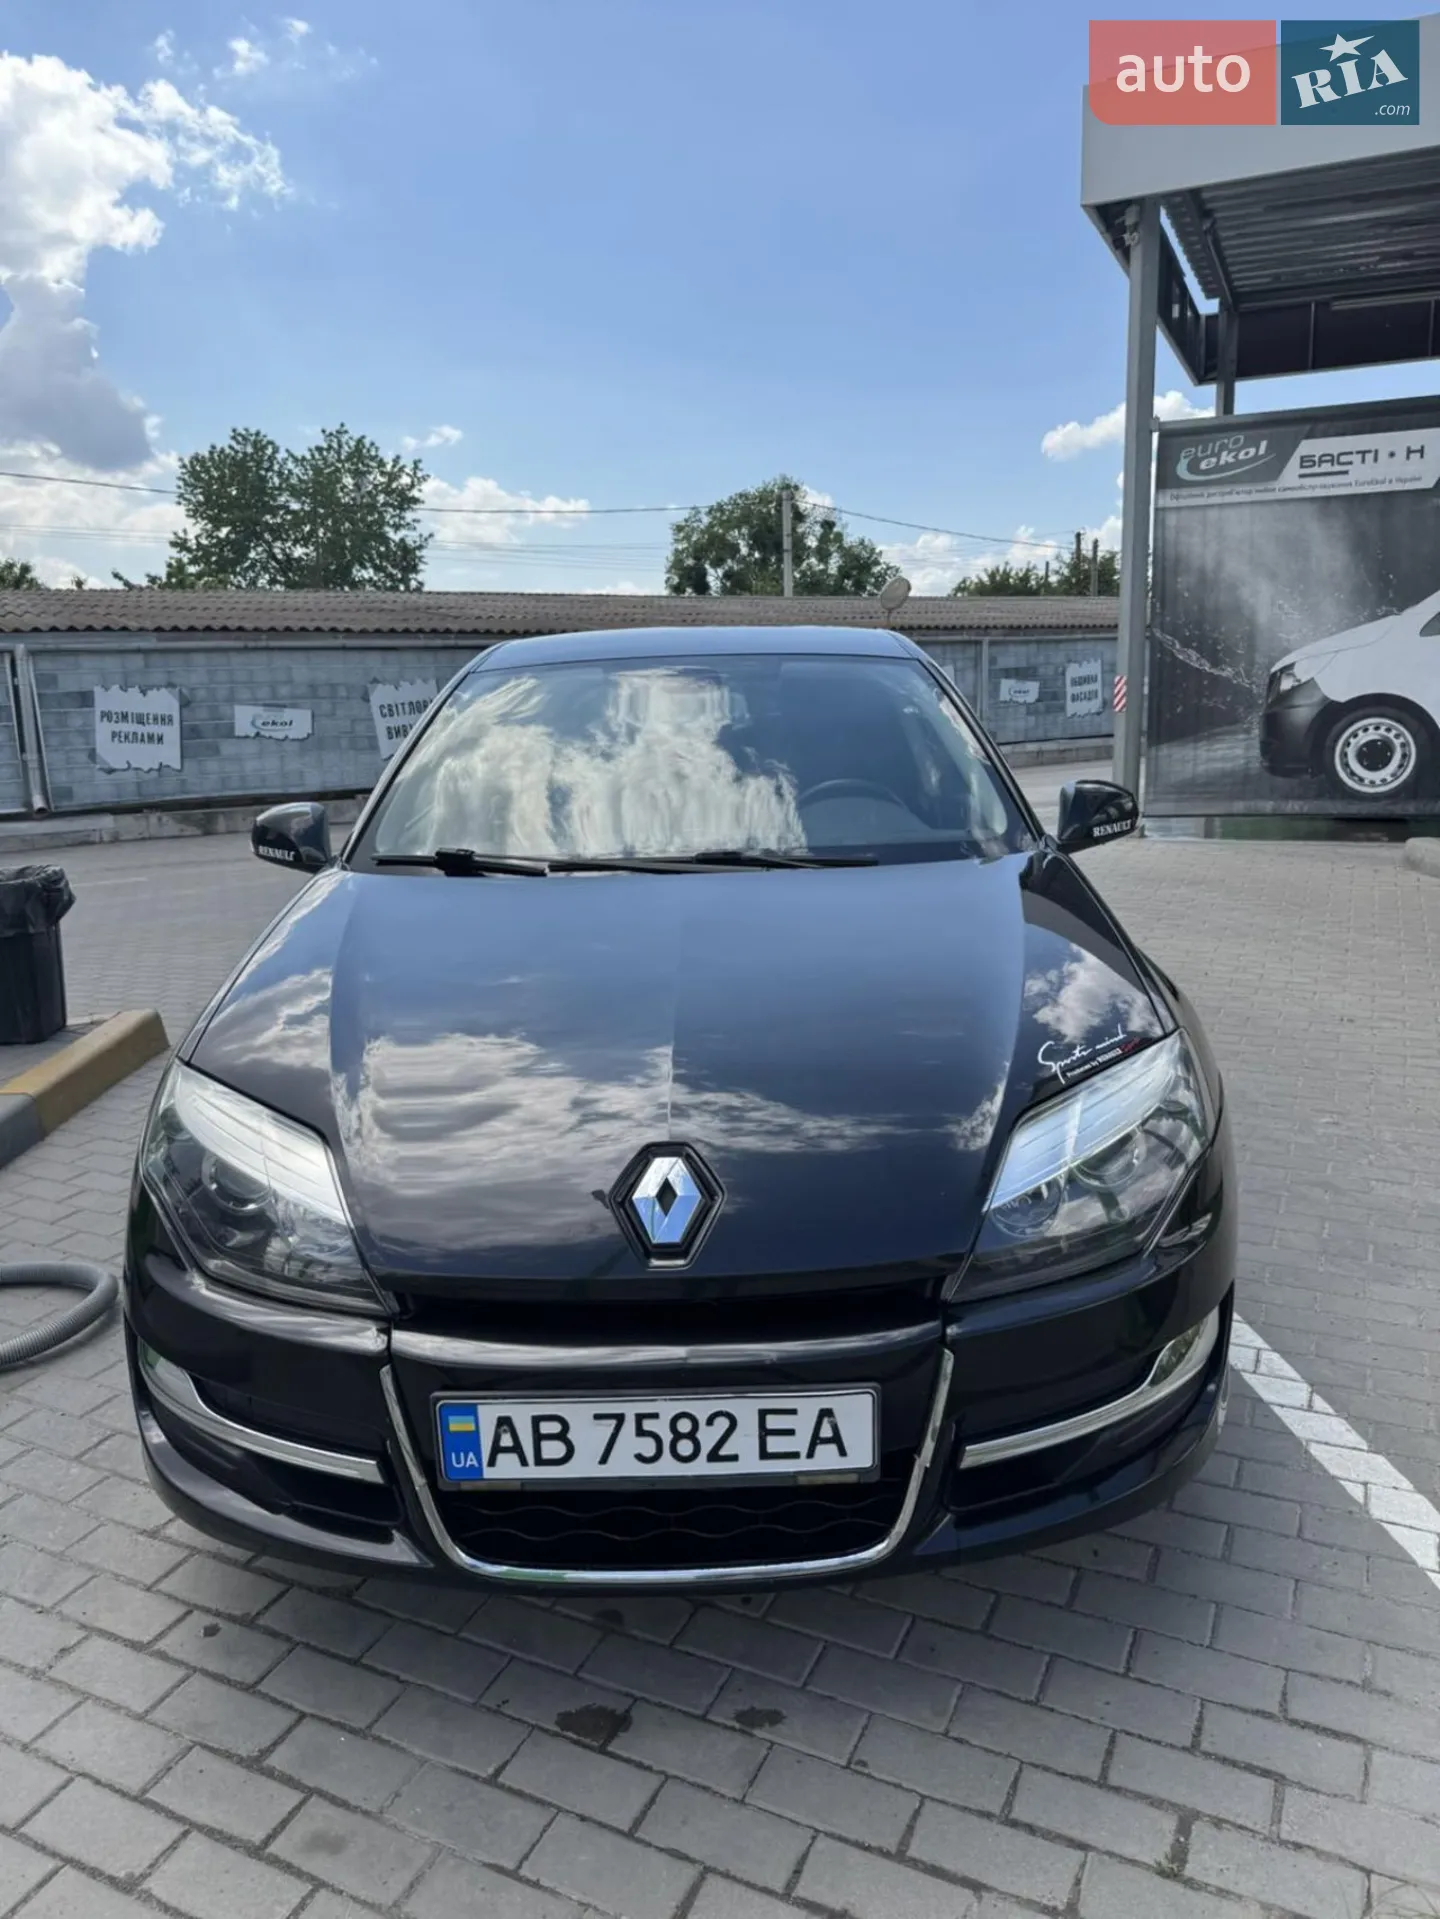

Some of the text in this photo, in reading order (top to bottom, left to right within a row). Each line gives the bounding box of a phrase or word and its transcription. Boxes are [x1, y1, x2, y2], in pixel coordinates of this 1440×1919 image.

[1180, 434, 1244, 460] euro
[1199, 440, 1268, 470] ekol
[379, 698, 433, 719] СВІТЛОВ
[100, 710, 174, 727] РОЗМІЩЕННЯ
[261, 720, 293, 728] ekol
[111, 730, 164, 745] РЕКЛАМИ
[486, 1407, 848, 1468] AB 7582 EA
[451, 1451, 479, 1469] UA
